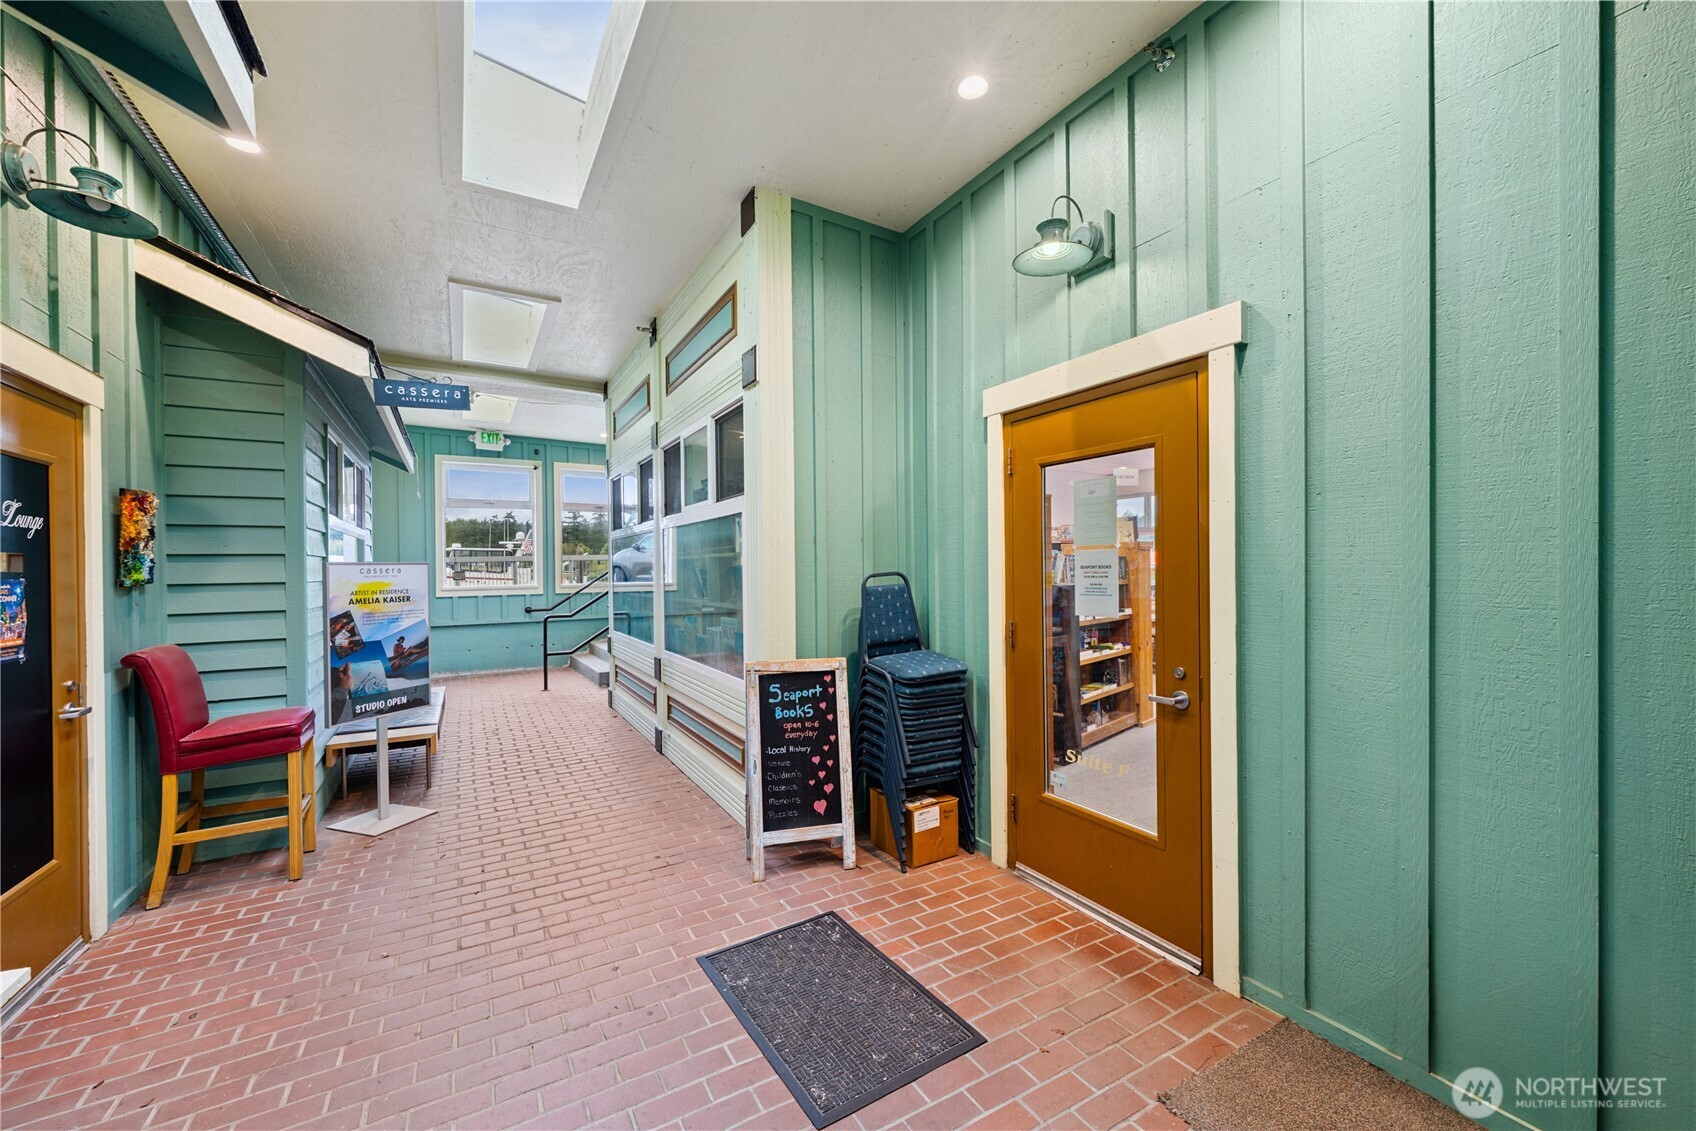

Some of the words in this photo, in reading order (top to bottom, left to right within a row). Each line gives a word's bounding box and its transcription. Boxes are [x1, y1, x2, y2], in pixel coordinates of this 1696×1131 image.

[384, 385, 461, 399] cassera
[481, 431, 500, 445] EXIT
[0, 498, 44, 539] Lounge
[359, 567, 402, 575] cassera
[348, 597, 380, 606] AMELIA
[383, 595, 411, 603] KAISER
[768, 684, 823, 703] Seaport
[355, 700, 385, 713] STUDIO
[386, 696, 407, 707] OPEN
[783, 722, 801, 731] open
[805, 720, 819, 728] 10-6
[785, 730, 818, 740] everyday
[789, 745, 811, 754] History
[1065, 749, 1112, 774] Suite
